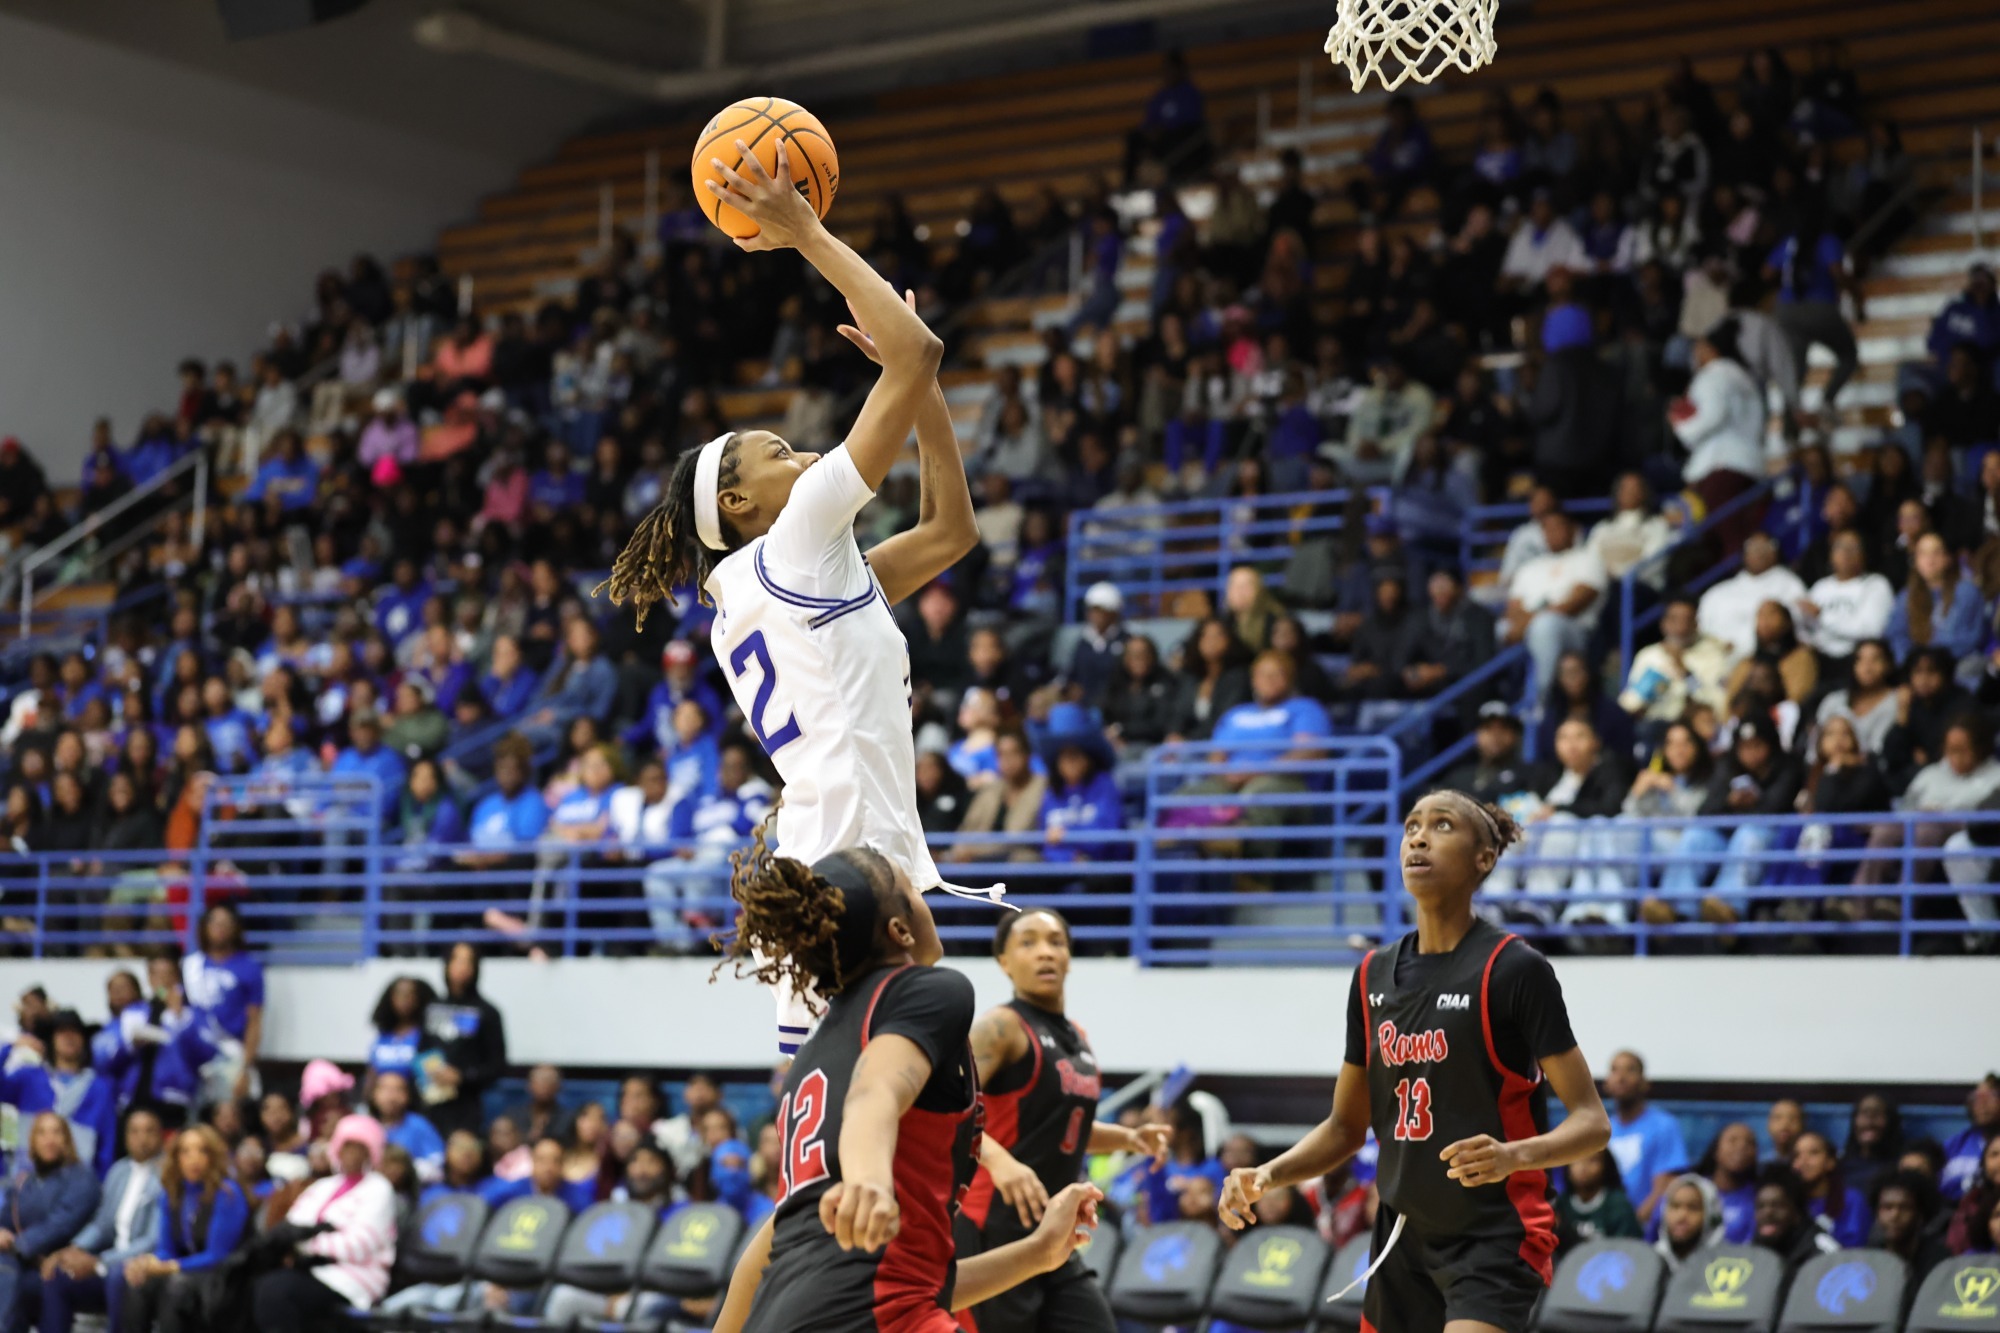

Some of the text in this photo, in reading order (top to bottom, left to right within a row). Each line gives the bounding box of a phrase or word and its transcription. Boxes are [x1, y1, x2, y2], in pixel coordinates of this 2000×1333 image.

[1436, 993, 1471, 1011] CIAA
[1378, 1020, 1449, 1068] Rams
[1394, 1077, 1434, 1142] 13
[774, 1067, 831, 1210] 12
